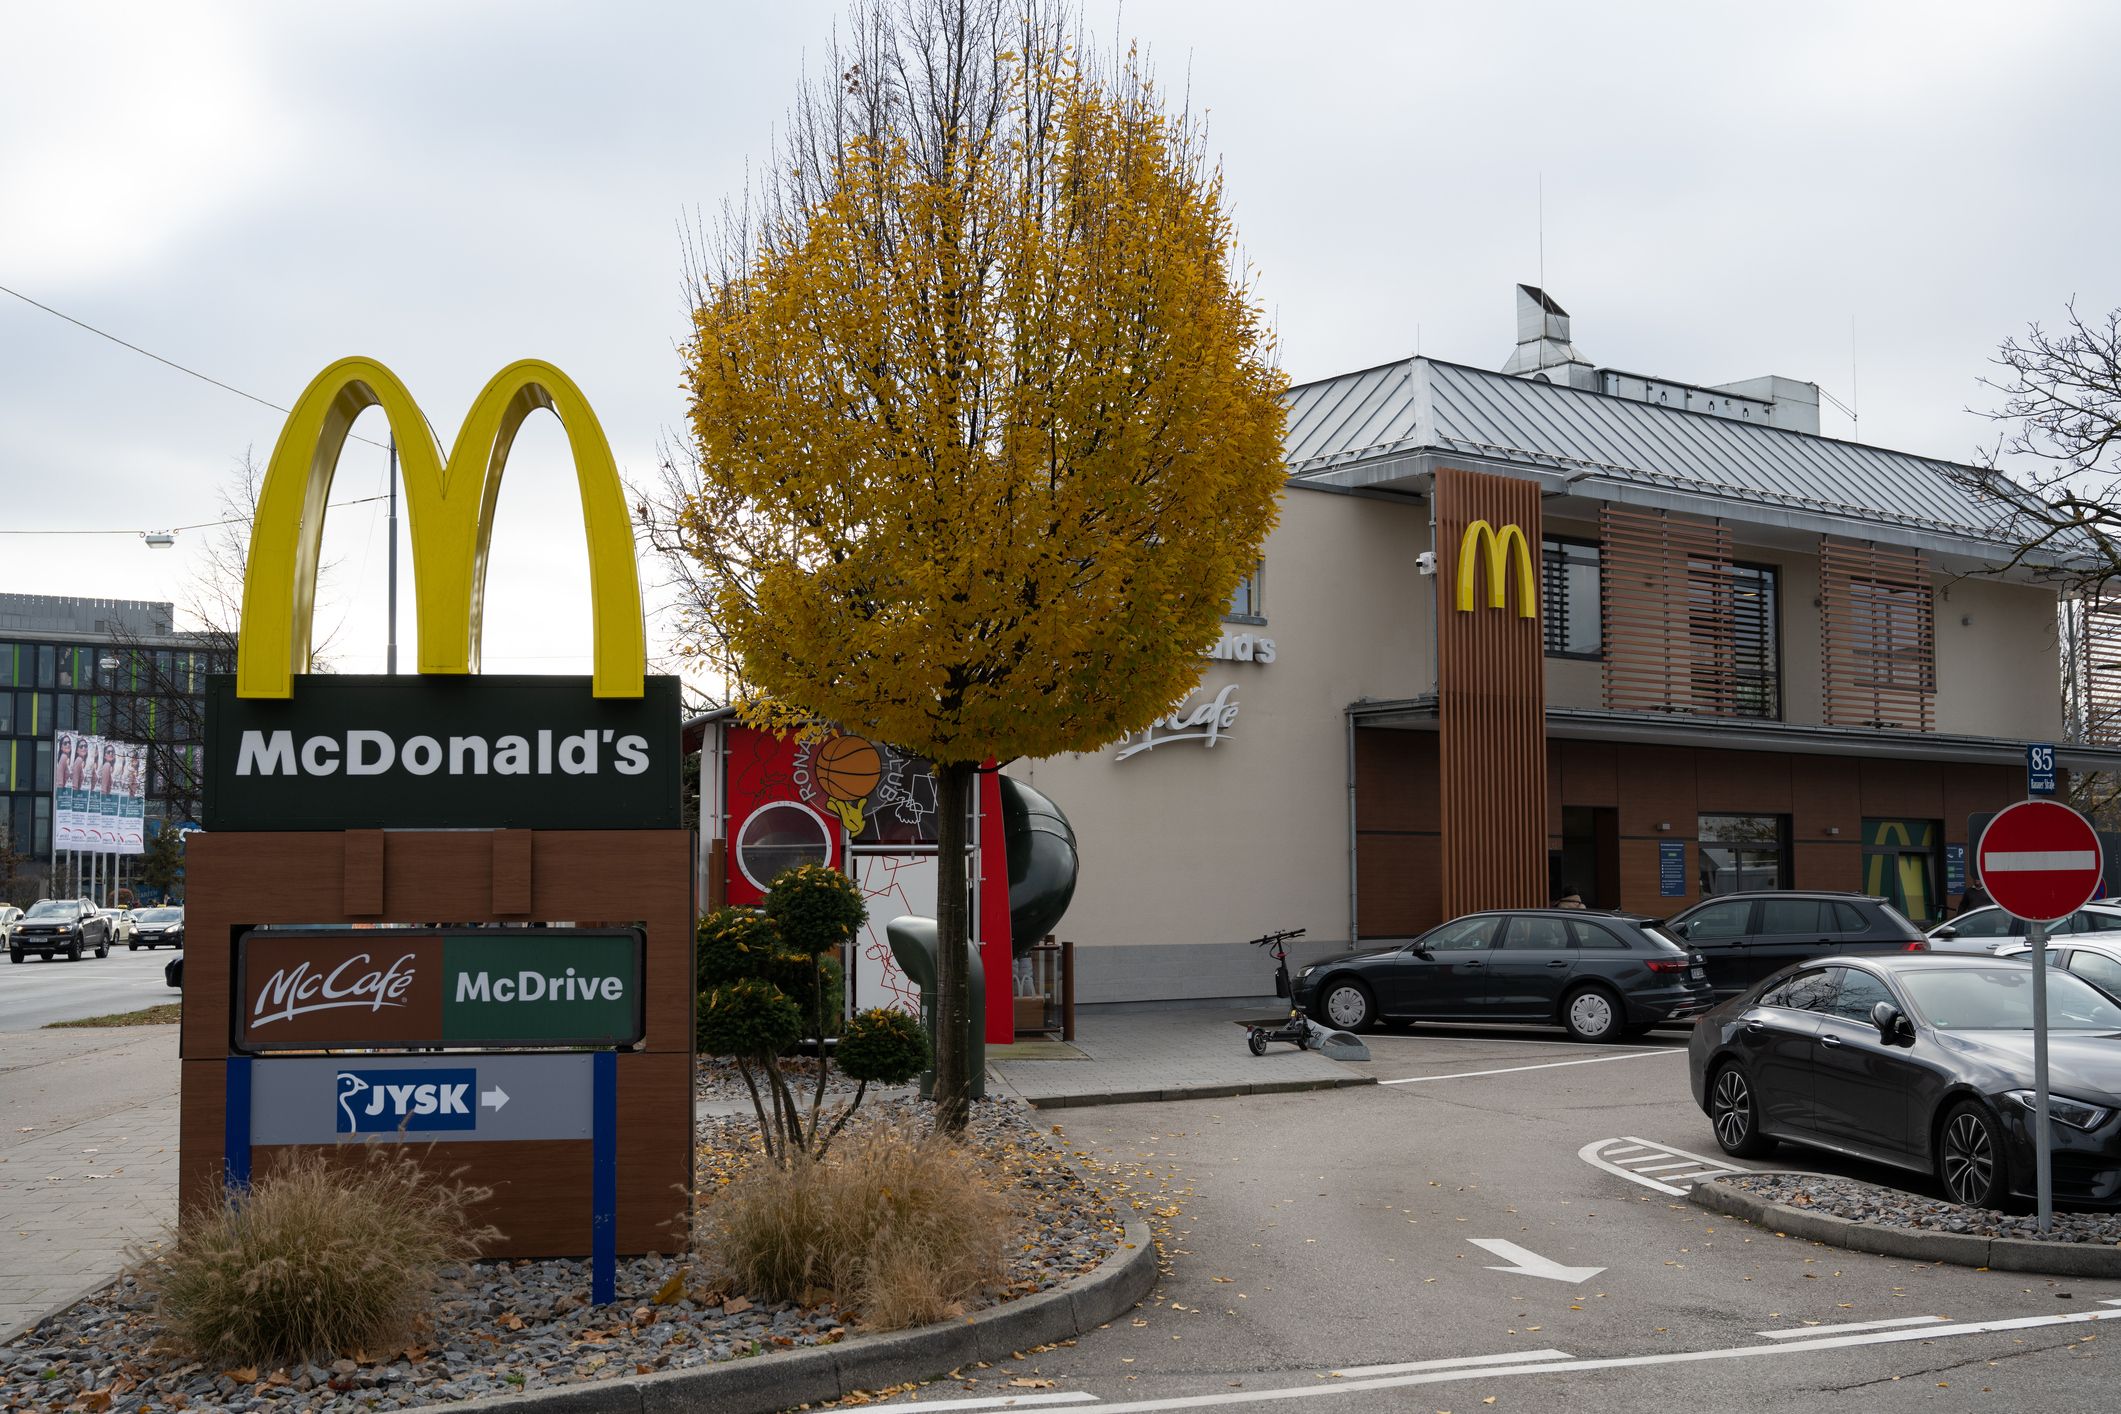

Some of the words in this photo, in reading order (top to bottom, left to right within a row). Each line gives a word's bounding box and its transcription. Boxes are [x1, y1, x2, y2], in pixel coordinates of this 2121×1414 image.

[235, 728, 650, 776] McDonald's
[2031, 747, 2053, 771] 85
[1958, 847, 1964, 858] P
[252, 953, 416, 1023] McCafé
[455, 967, 623, 1003] McDrive
[364, 1082, 470, 1117] JYSK
